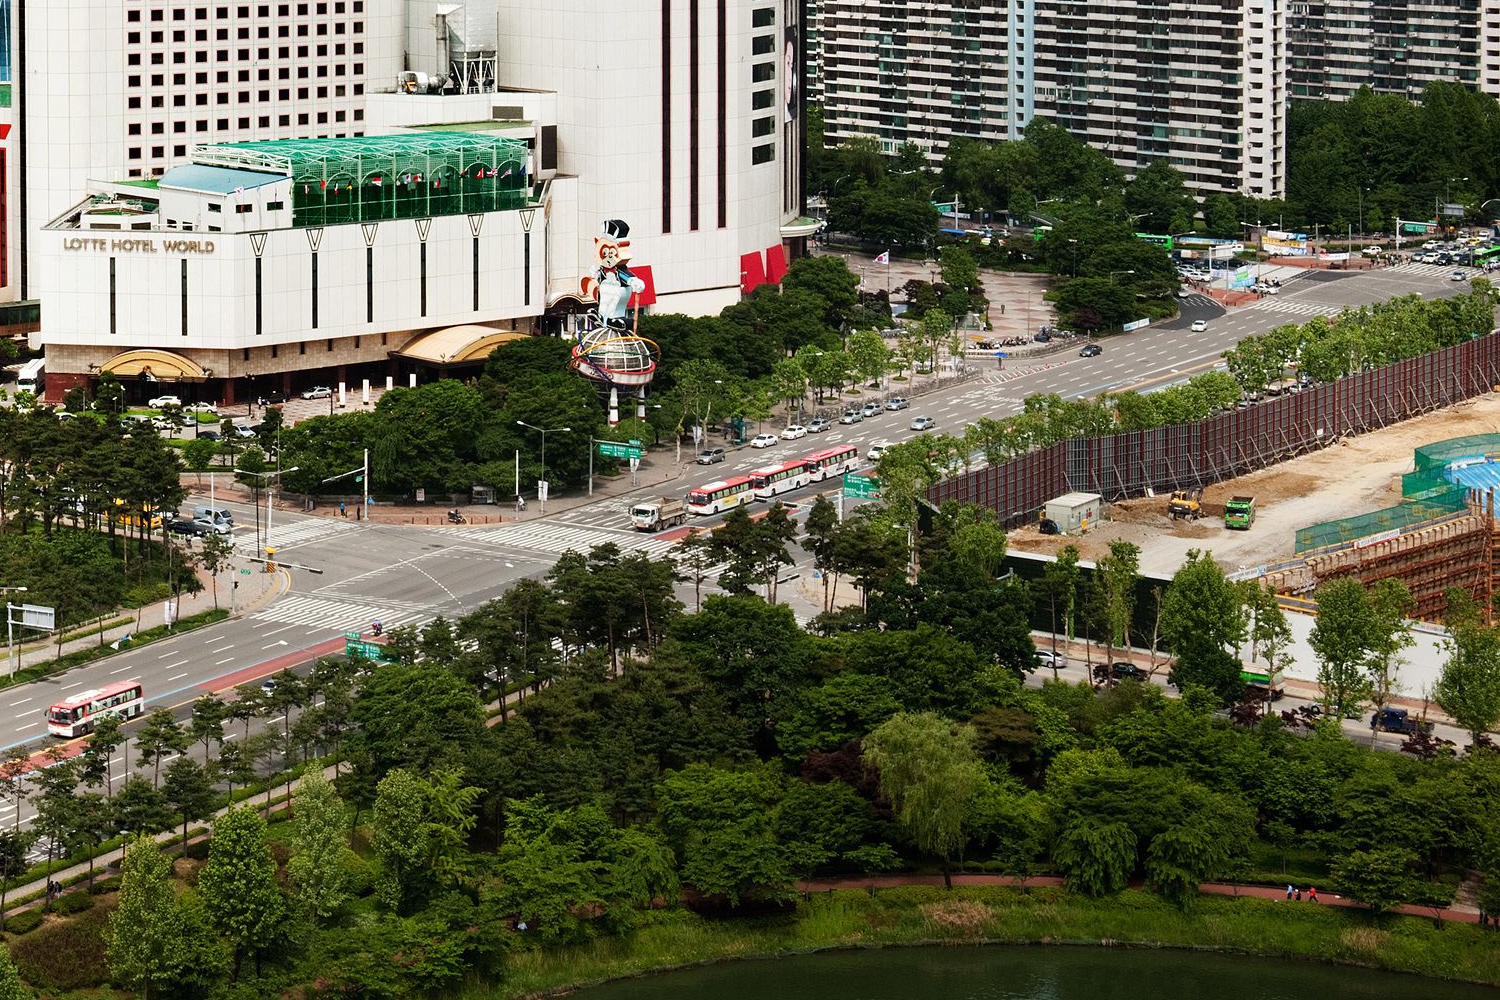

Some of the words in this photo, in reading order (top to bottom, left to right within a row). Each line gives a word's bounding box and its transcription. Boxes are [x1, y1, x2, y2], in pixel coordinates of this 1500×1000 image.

[63, 237, 107, 251] LOTTE
[111, 239, 157, 253] HOTEL
[163, 240, 215, 254] WORLD
